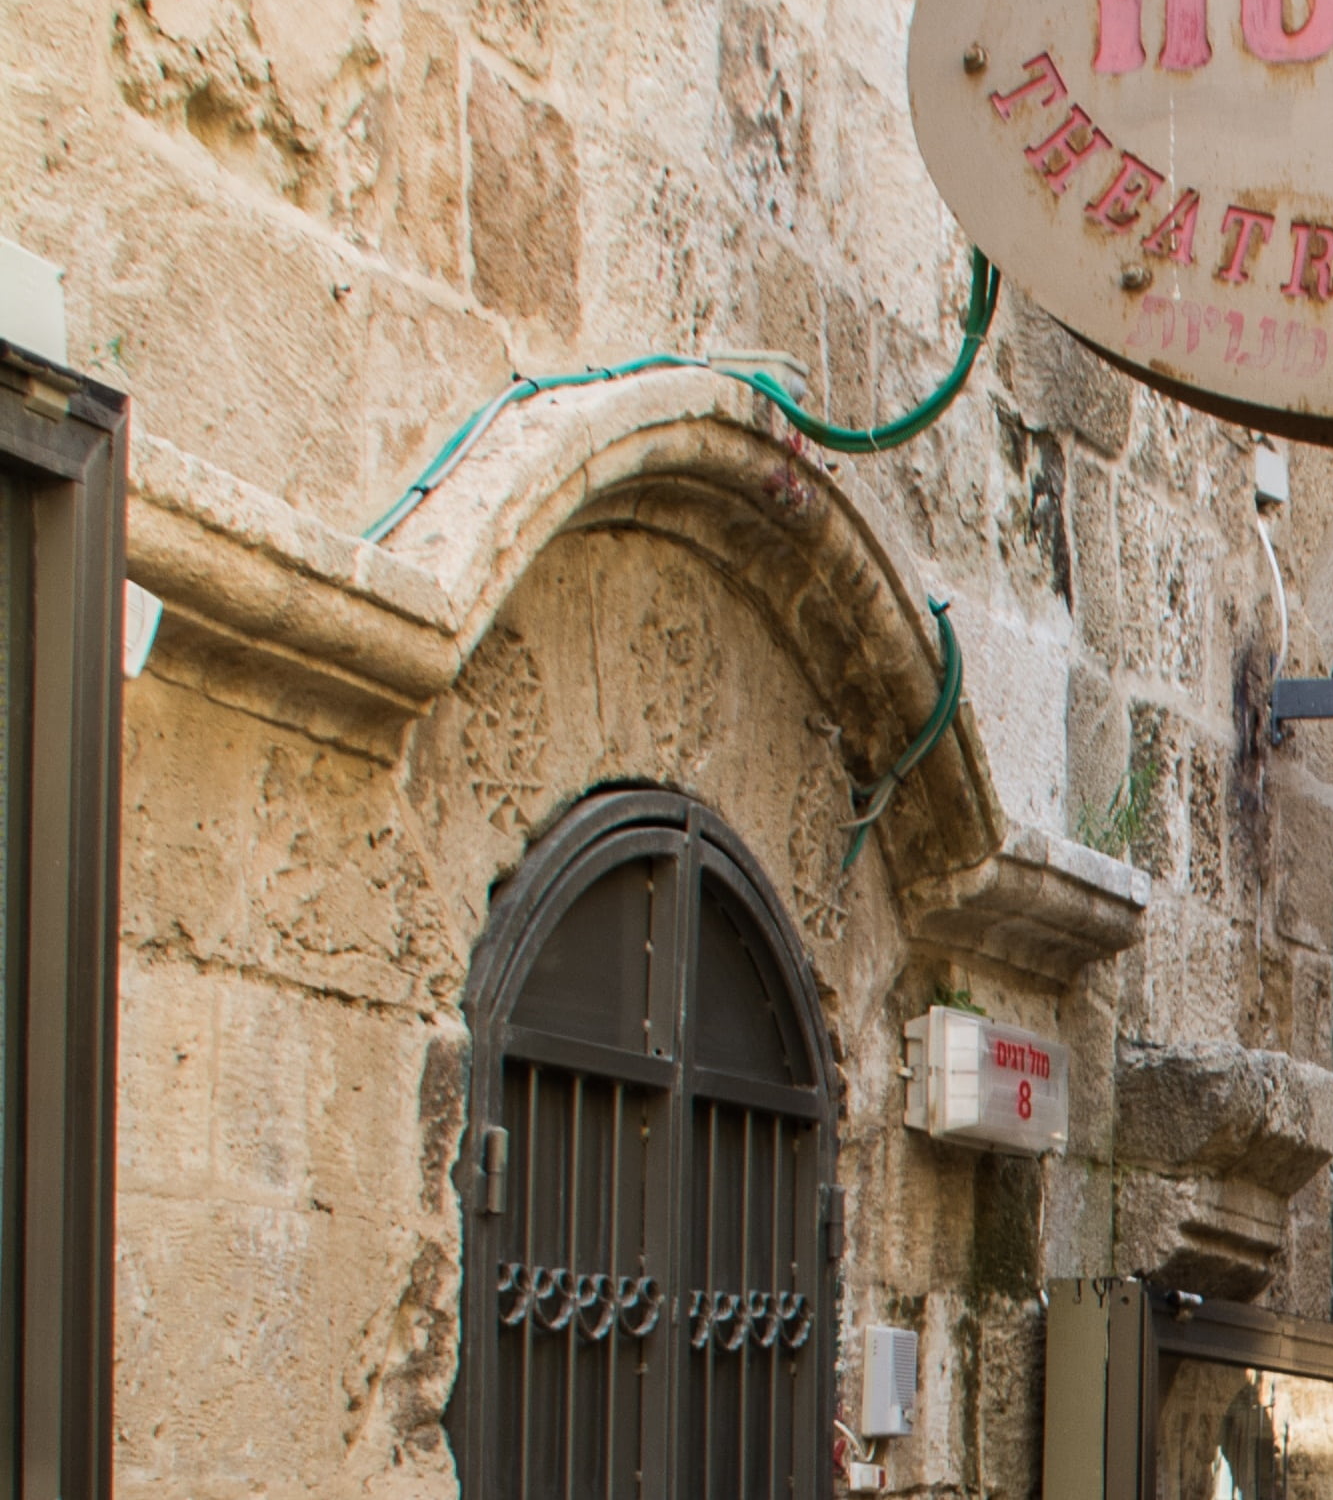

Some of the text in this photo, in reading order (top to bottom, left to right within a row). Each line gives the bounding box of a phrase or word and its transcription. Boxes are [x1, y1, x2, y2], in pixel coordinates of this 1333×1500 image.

[995, 1040, 1050, 1079] מזל דגים
[1018, 1079, 1032, 1121] 8
